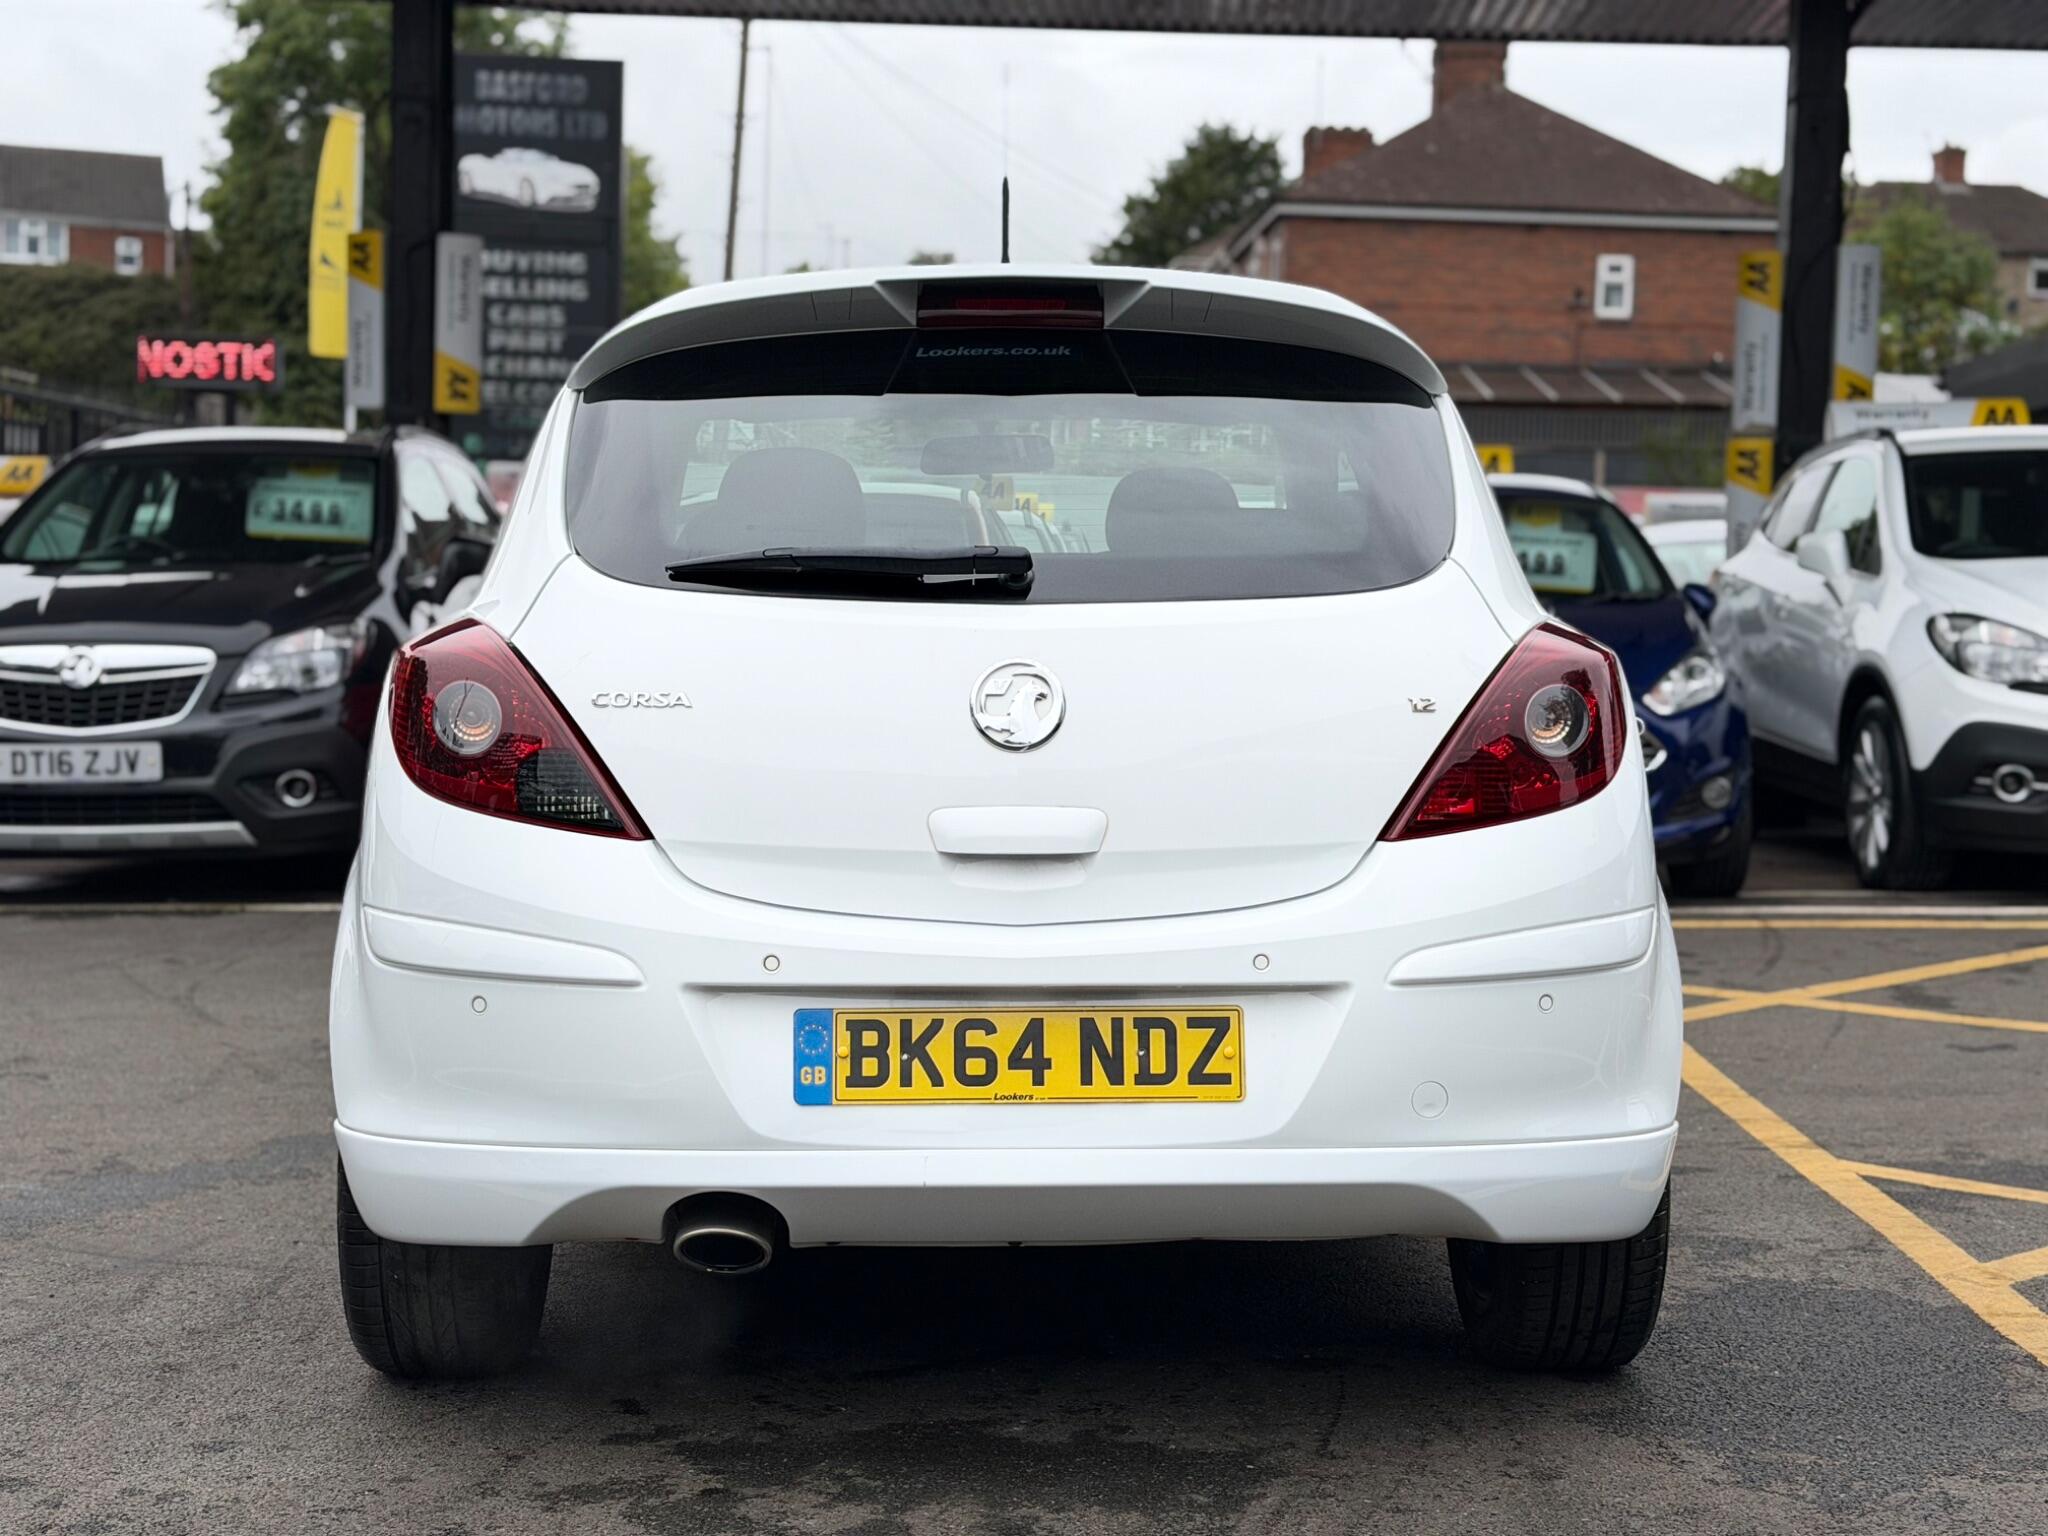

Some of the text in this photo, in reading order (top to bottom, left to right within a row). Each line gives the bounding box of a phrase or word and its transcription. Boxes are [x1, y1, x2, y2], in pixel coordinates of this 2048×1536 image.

[916, 345, 1071, 358] Lookers.co.uk
[591, 691, 693, 708] CORSA
[11, 749, 141, 776] DT16 ZJV
[845, 1016, 1234, 1089] BK64 NDZ
[801, 1066, 826, 1085] GB
[993, 1092, 1035, 1102] Lookers
